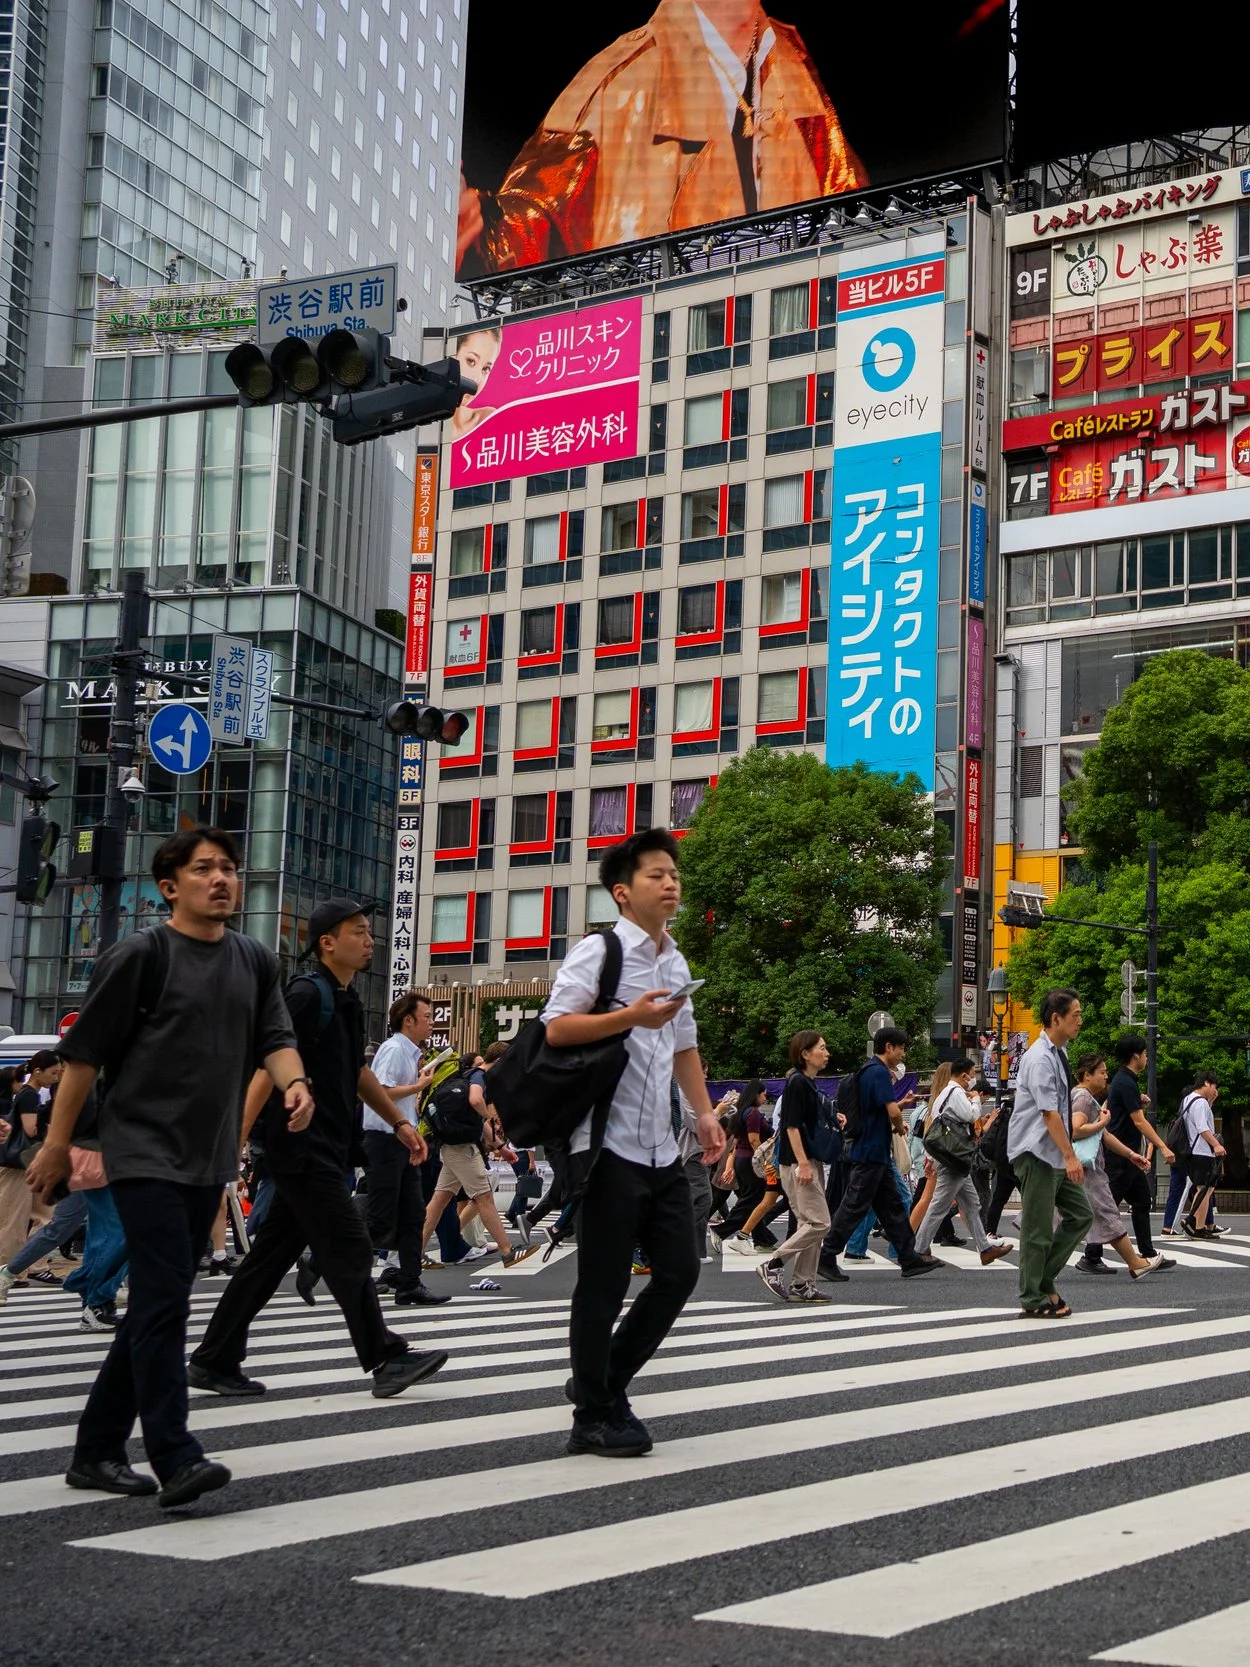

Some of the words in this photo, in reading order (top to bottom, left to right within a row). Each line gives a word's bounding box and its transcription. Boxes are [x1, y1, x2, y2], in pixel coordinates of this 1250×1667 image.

[1033, 174, 1222, 235] しゃぶしゃぶバイキング
[1115, 223, 1223, 279] しゃぶ葉
[268, 277, 385, 325] 渋谷駅前
[848, 266, 934, 305] 当ビル5F
[1016, 268, 1048, 295] 9F
[109, 311, 190, 327] MARK
[149, 296, 227, 309] SHIBUYA
[344, 315, 370, 331] Sta.
[535, 316, 632, 358] 品川スキン
[535, 346, 620, 385] クリニック
[1056, 320, 1230, 386] プライス
[847, 393, 928, 430] eyecity
[975, 376, 985, 455] 献血ルーム
[1159, 385, 1245, 431] ガスト
[477, 410, 628, 469] 品川美容外科
[1010, 472, 1049, 503] 7F
[1058, 463, 1103, 488] Café
[1109, 445, 1216, 501] ガスト
[417, 472, 431, 551] 東京スター銀行
[416, 554, 428, 563] 8F
[412, 574, 428, 627] 外貨両替
[840, 488, 888, 739] アイシティ
[889, 482, 925, 736] コンタクトの
[213, 657, 226, 697] Shibuya
[223, 646, 245, 735] 渋谷駅前
[251, 653, 270, 737] スクランブル式
[409, 673, 423, 681] 7F
[970, 640, 980, 726] 品川美容外科
[212, 701, 223, 721] Sta.
[969, 733, 980, 744] 4F
[401, 791, 418, 802] 5F
[968, 762, 979, 824] 外貨両替
[400, 818, 417, 828] 3F
[397, 855, 415, 884] 内科
[965, 877, 976, 888] 7F
[434, 1007, 451, 1022] 2F
